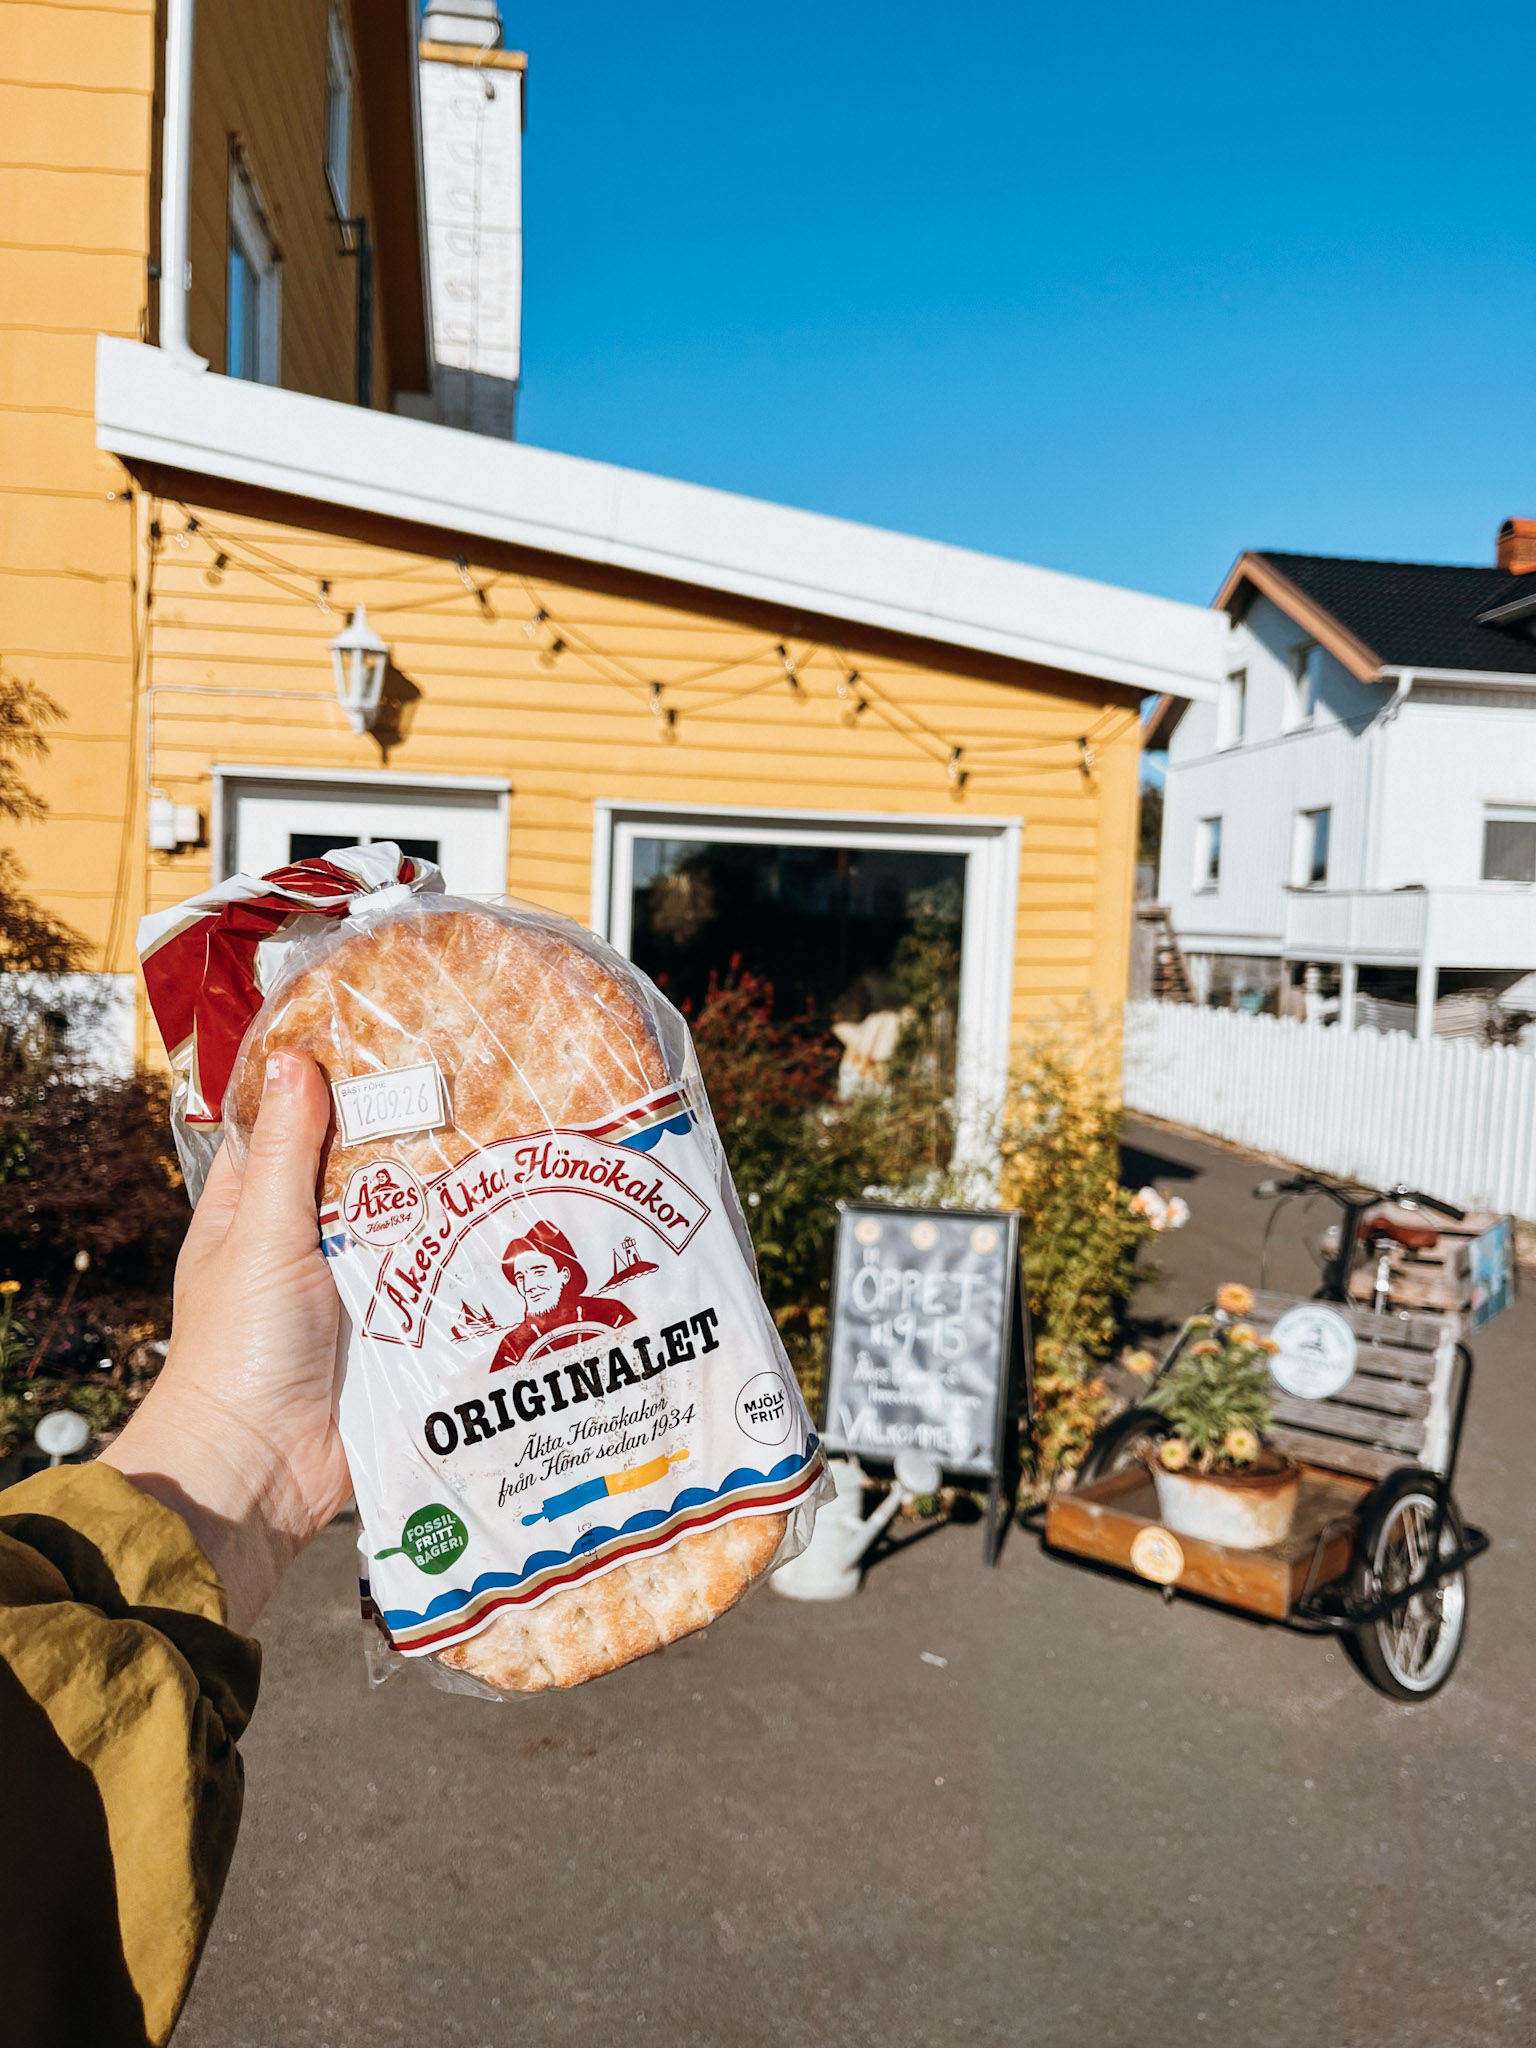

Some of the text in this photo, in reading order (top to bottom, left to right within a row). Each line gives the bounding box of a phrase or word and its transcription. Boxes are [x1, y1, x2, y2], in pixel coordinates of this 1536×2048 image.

[345, 1175, 418, 1223] Åkes
[383, 1141, 690, 1333] Åkes Äkta Hönökakor
[424, 1307, 720, 1456] ORIGINALET
[750, 1403, 785, 1424] FRITT
[498, 1473, 537, 1508] från
[595, 1431, 650, 1459] sedan
[651, 1403, 697, 1442] 1934
[414, 1535, 464, 1567] BAGERI
[415, 1525, 454, 1553] FRITT
